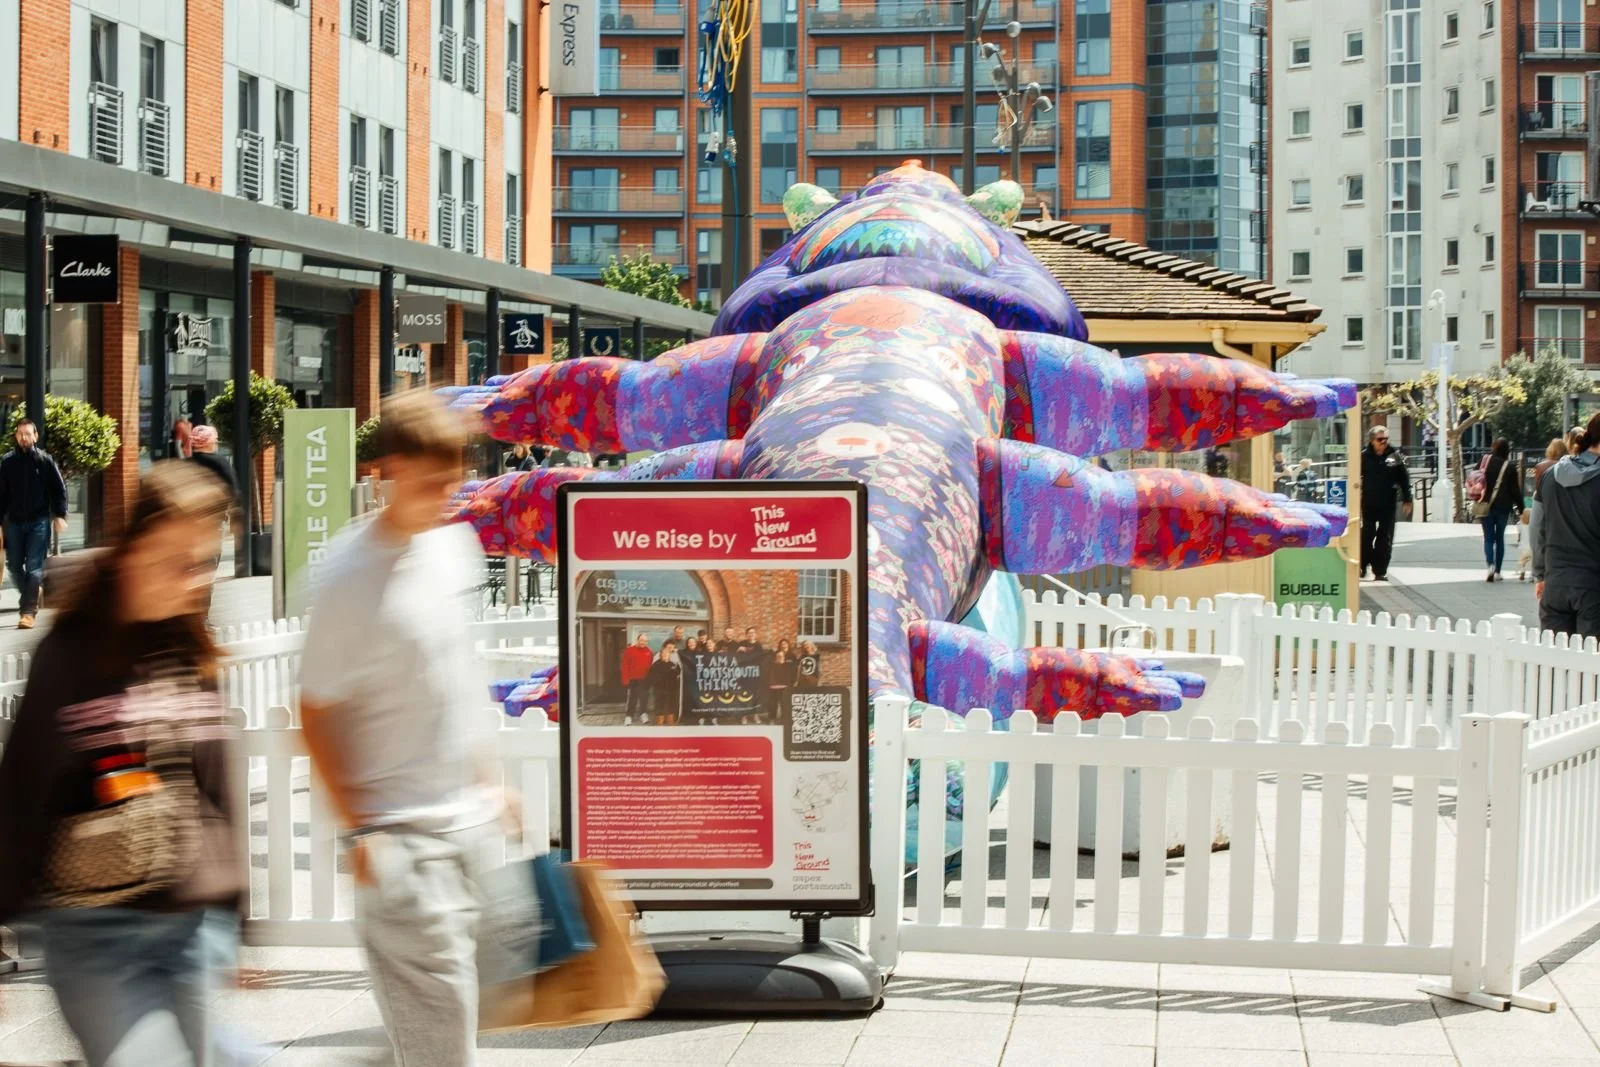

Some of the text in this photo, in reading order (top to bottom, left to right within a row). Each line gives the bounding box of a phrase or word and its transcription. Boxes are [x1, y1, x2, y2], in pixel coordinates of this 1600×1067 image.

[559, 4, 579, 66] Express
[60, 261, 112, 277] Clarks
[402, 313, 442, 326] MOSS
[306, 425, 328, 479] TEA
[306, 483, 328, 508] CI
[751, 504, 785, 521] This
[754, 521, 790, 536] New
[613, 529, 737, 554] We Rise by
[756, 528, 817, 549] Ground
[596, 578, 648, 593] aspex
[1279, 583, 1340, 596] BUBBLE
[596, 593, 697, 609] portsmouth
[695, 655, 738, 667] I AM A
[696, 665, 760, 680] PORTSMOUTH
[793, 842, 812, 851] This
[795, 859, 830, 869] Ground
[792, 875, 821, 883] aspex
[792, 881, 852, 892] portsmouth
